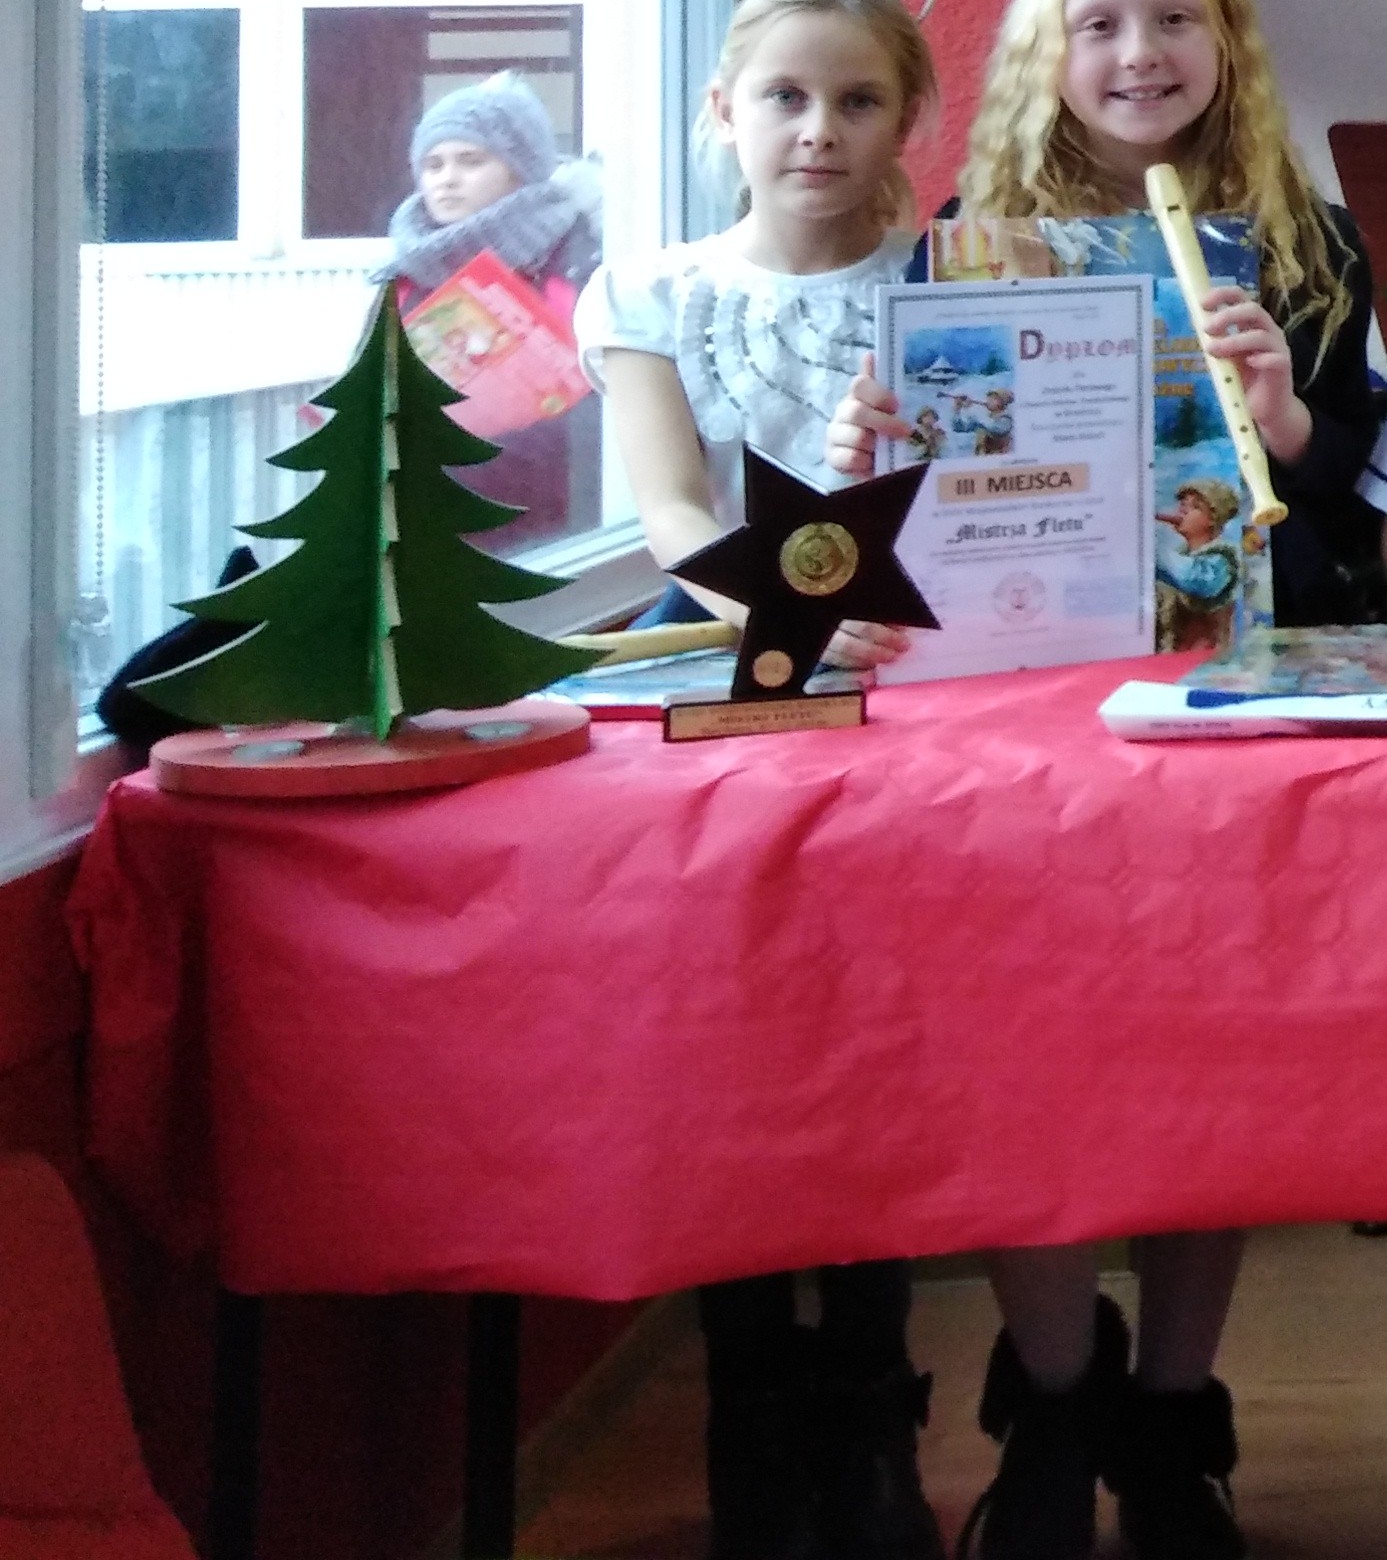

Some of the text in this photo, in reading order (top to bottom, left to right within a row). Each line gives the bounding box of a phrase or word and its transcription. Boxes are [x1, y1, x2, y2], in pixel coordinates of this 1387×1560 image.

[1019, 329, 1136, 363] Dyplom
[956, 471, 1073, 495] III MIEJSCA
